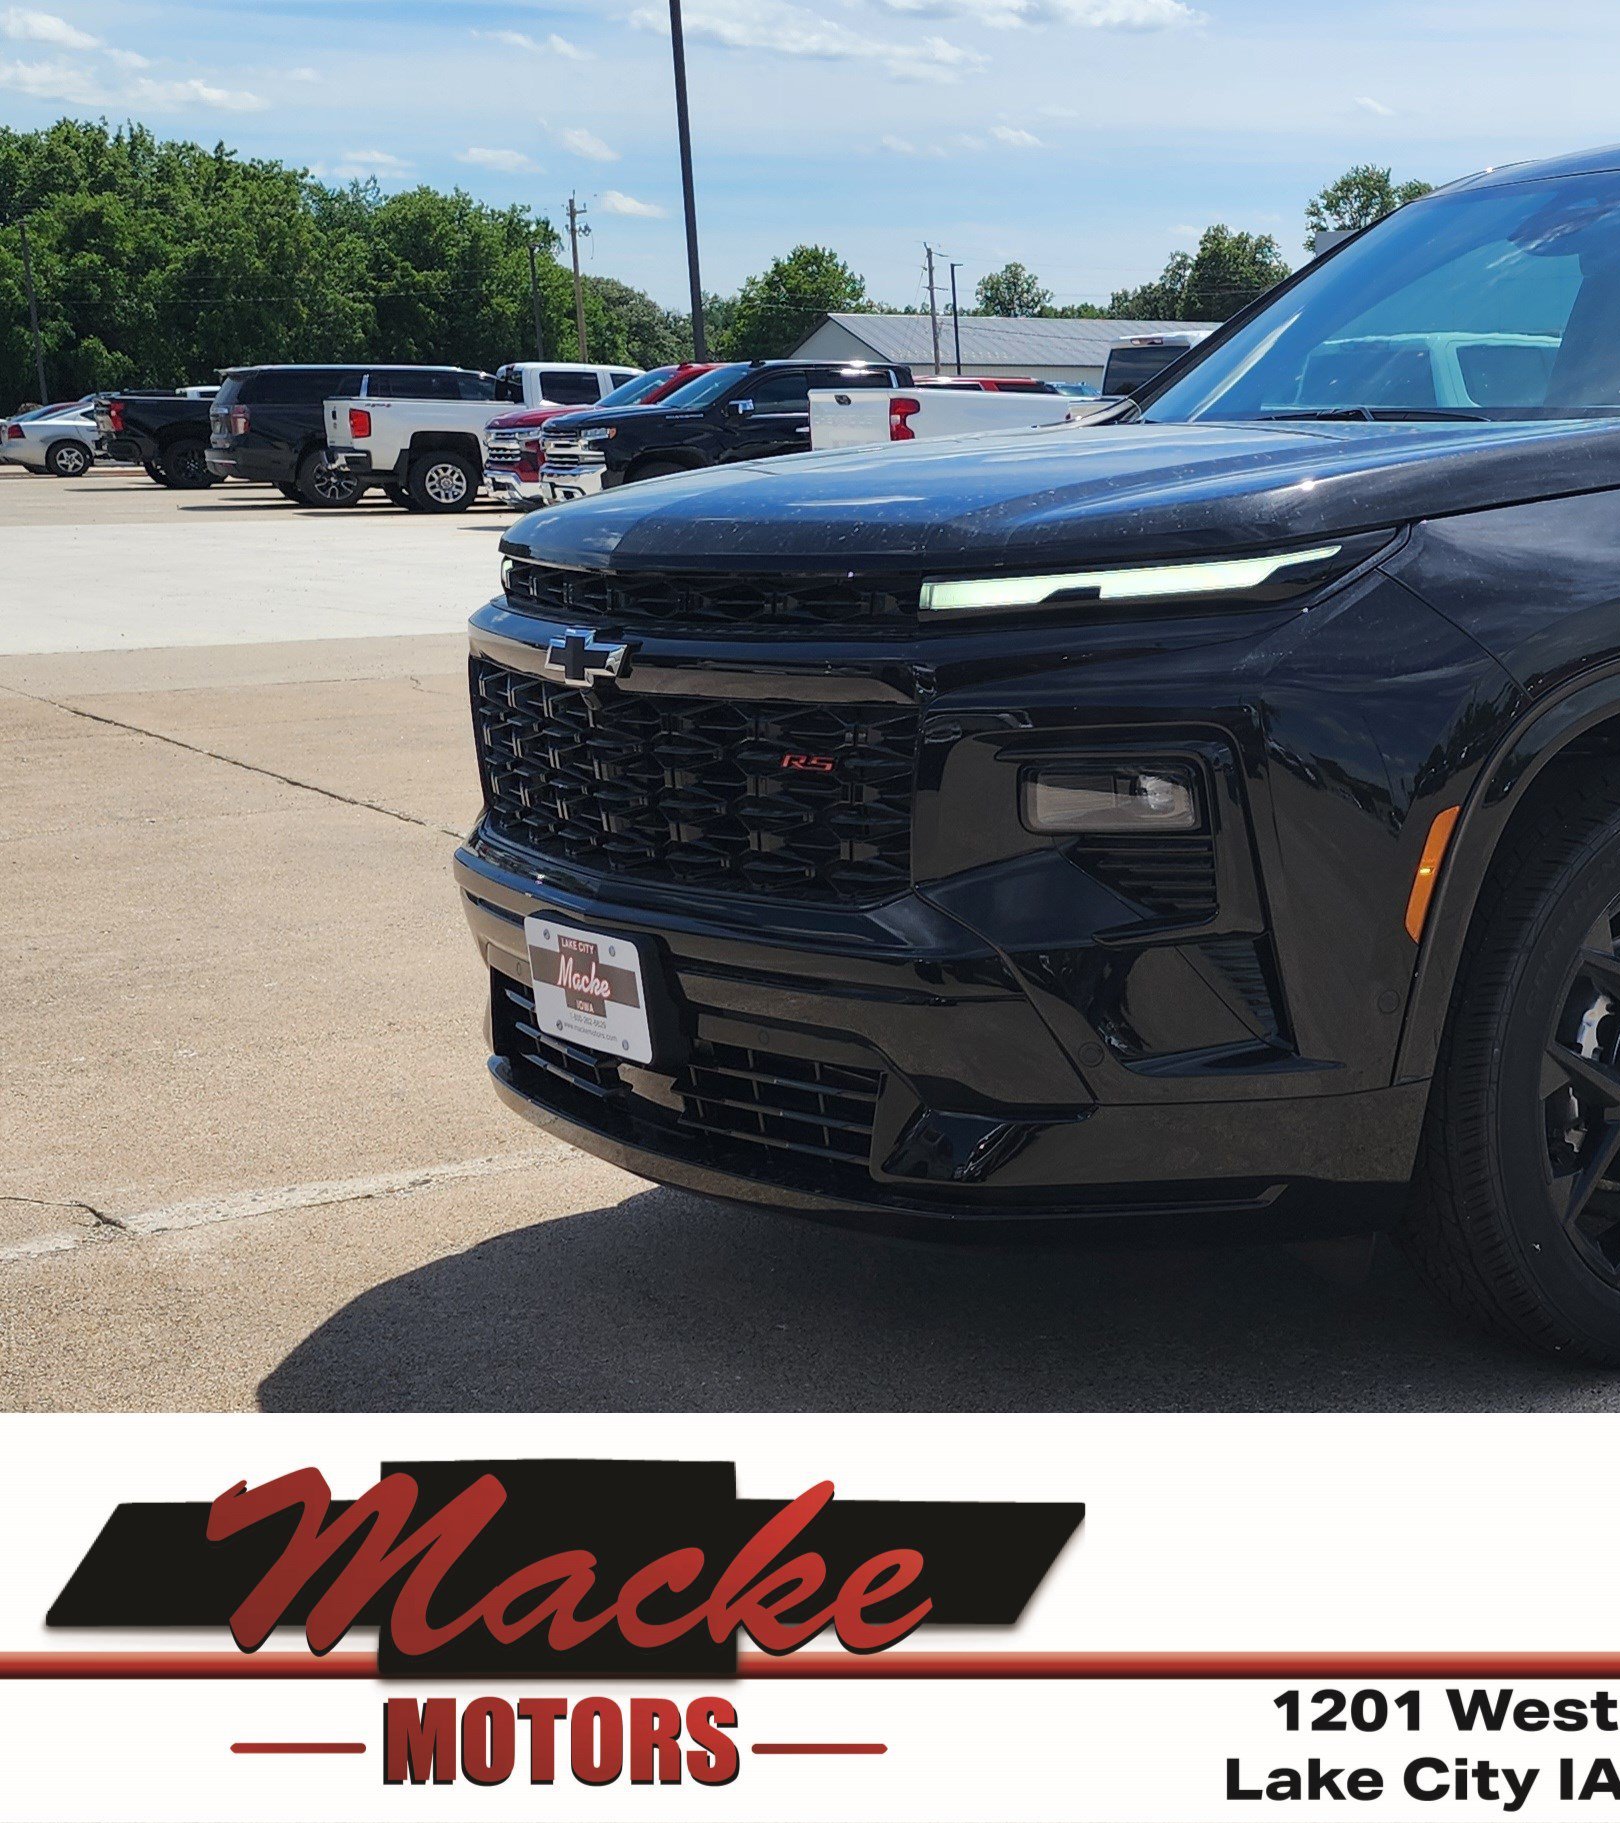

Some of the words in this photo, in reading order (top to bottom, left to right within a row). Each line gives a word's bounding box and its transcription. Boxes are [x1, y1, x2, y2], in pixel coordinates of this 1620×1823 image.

[782, 753, 834, 772] RS
[562, 939, 577, 951] LAKE
[579, 943, 594, 954] CITY
[557, 954, 611, 998] Macke
[576, 1001, 594, 1013] IOWA
